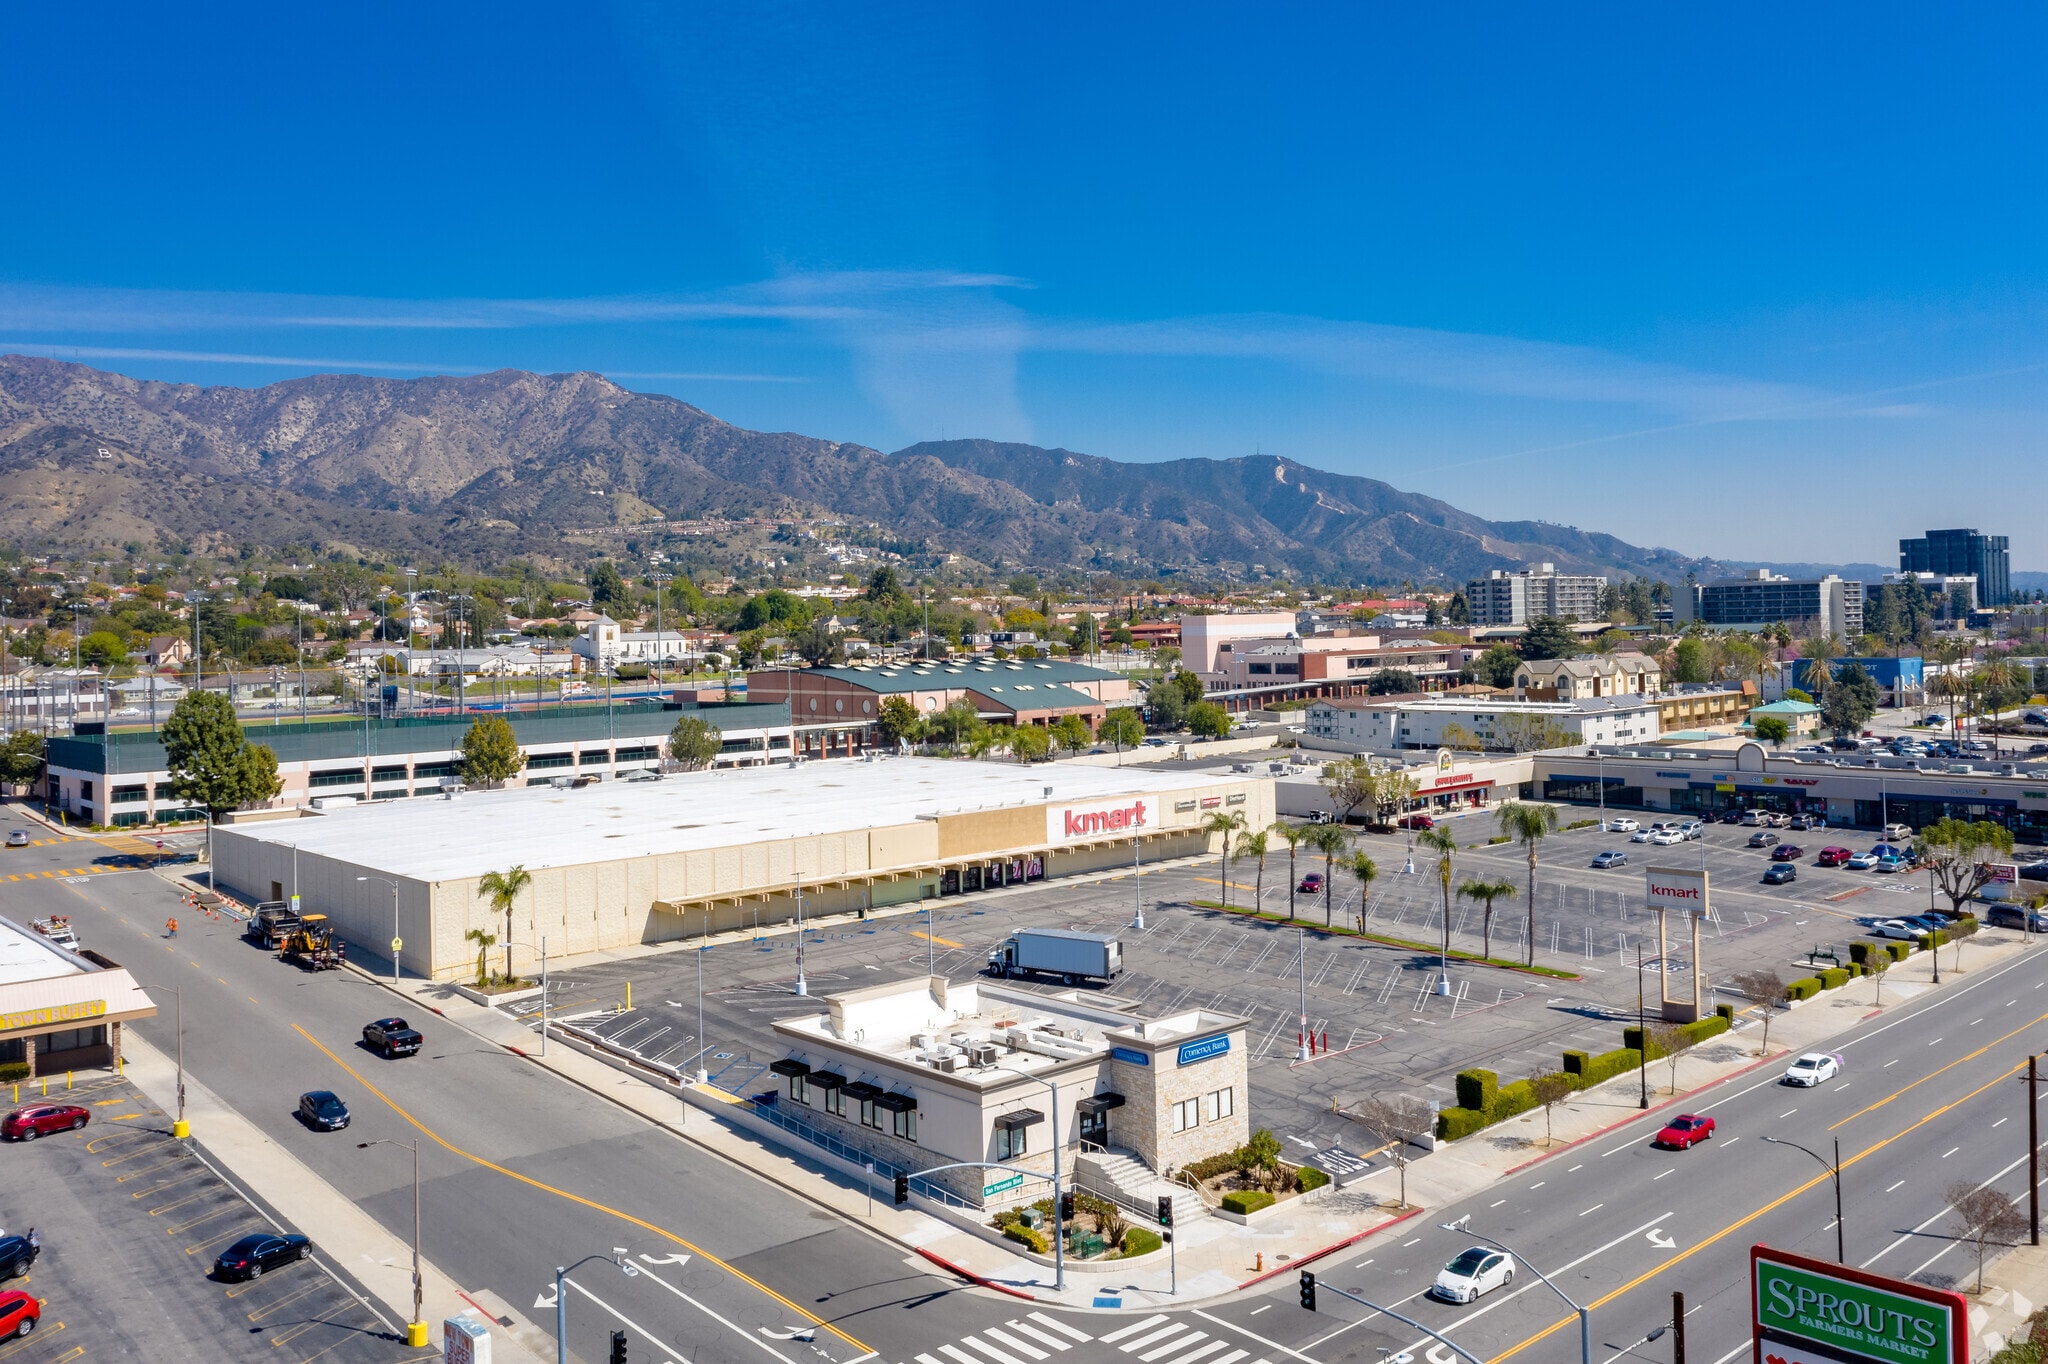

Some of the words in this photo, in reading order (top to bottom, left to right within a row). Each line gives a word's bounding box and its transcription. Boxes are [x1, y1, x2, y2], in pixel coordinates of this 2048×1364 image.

[1064, 801, 1146, 836] kmart
[1651, 883, 1699, 900] kmart
[2, 1010, 47, 1027] TOWN
[51, 1002, 102, 1020] BUFFET
[1212, 1040, 1227, 1050] Bank
[985, 1187, 994, 1195] San
[994, 1181, 1013, 1192] Fernando
[1013, 1177, 1022, 1185] Blvd
[1766, 1278, 1937, 1347] SPROUTS
[1799, 1315, 1864, 1341] FARMERS
[1867, 1333, 1929, 1360] MARKET
